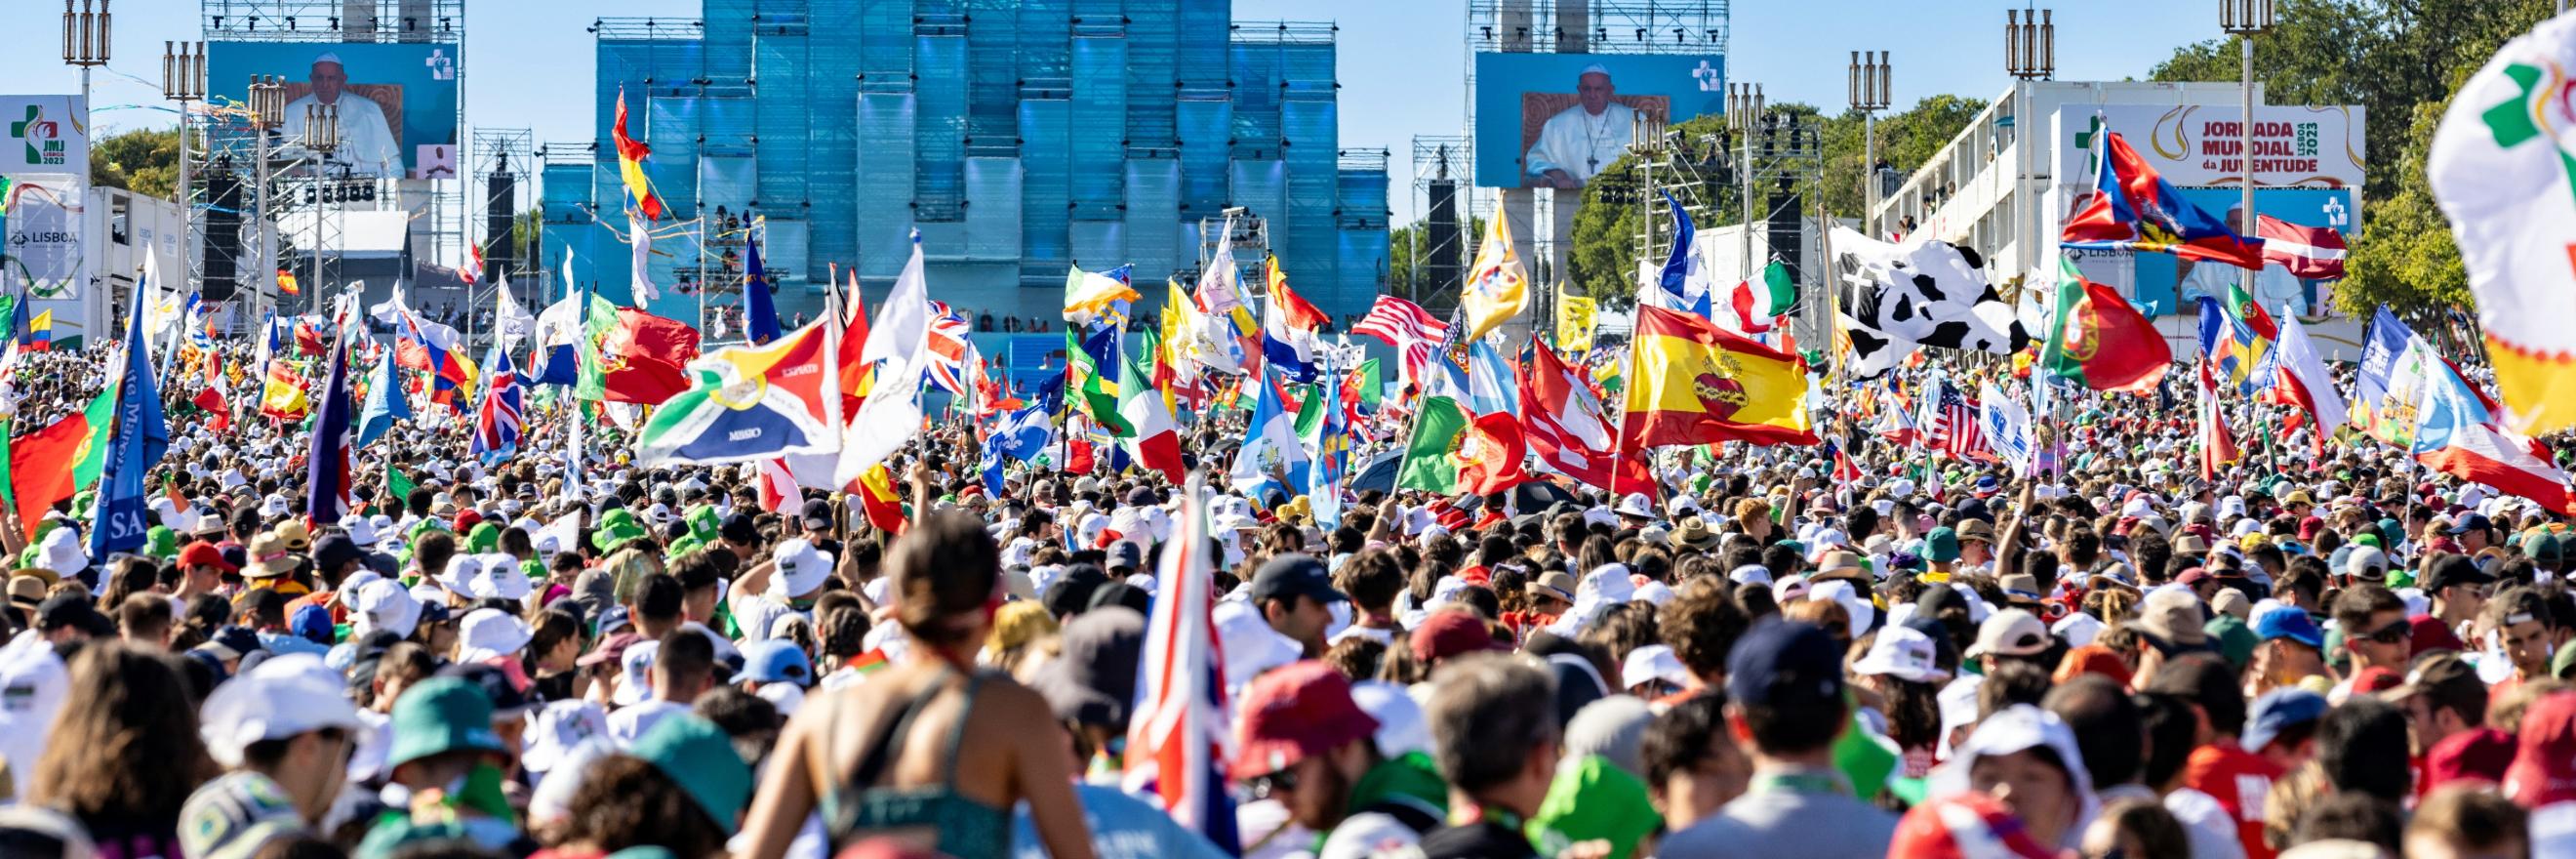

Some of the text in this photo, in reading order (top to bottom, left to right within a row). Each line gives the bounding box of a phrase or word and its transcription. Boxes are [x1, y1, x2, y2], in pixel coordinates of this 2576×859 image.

[2203, 122, 2294, 137] JORADA
[2307, 122, 2318, 156] 2023
[43, 140, 64, 151] JMJ
[2203, 159, 2217, 170] da
[32, 232, 77, 243] LISBOA
